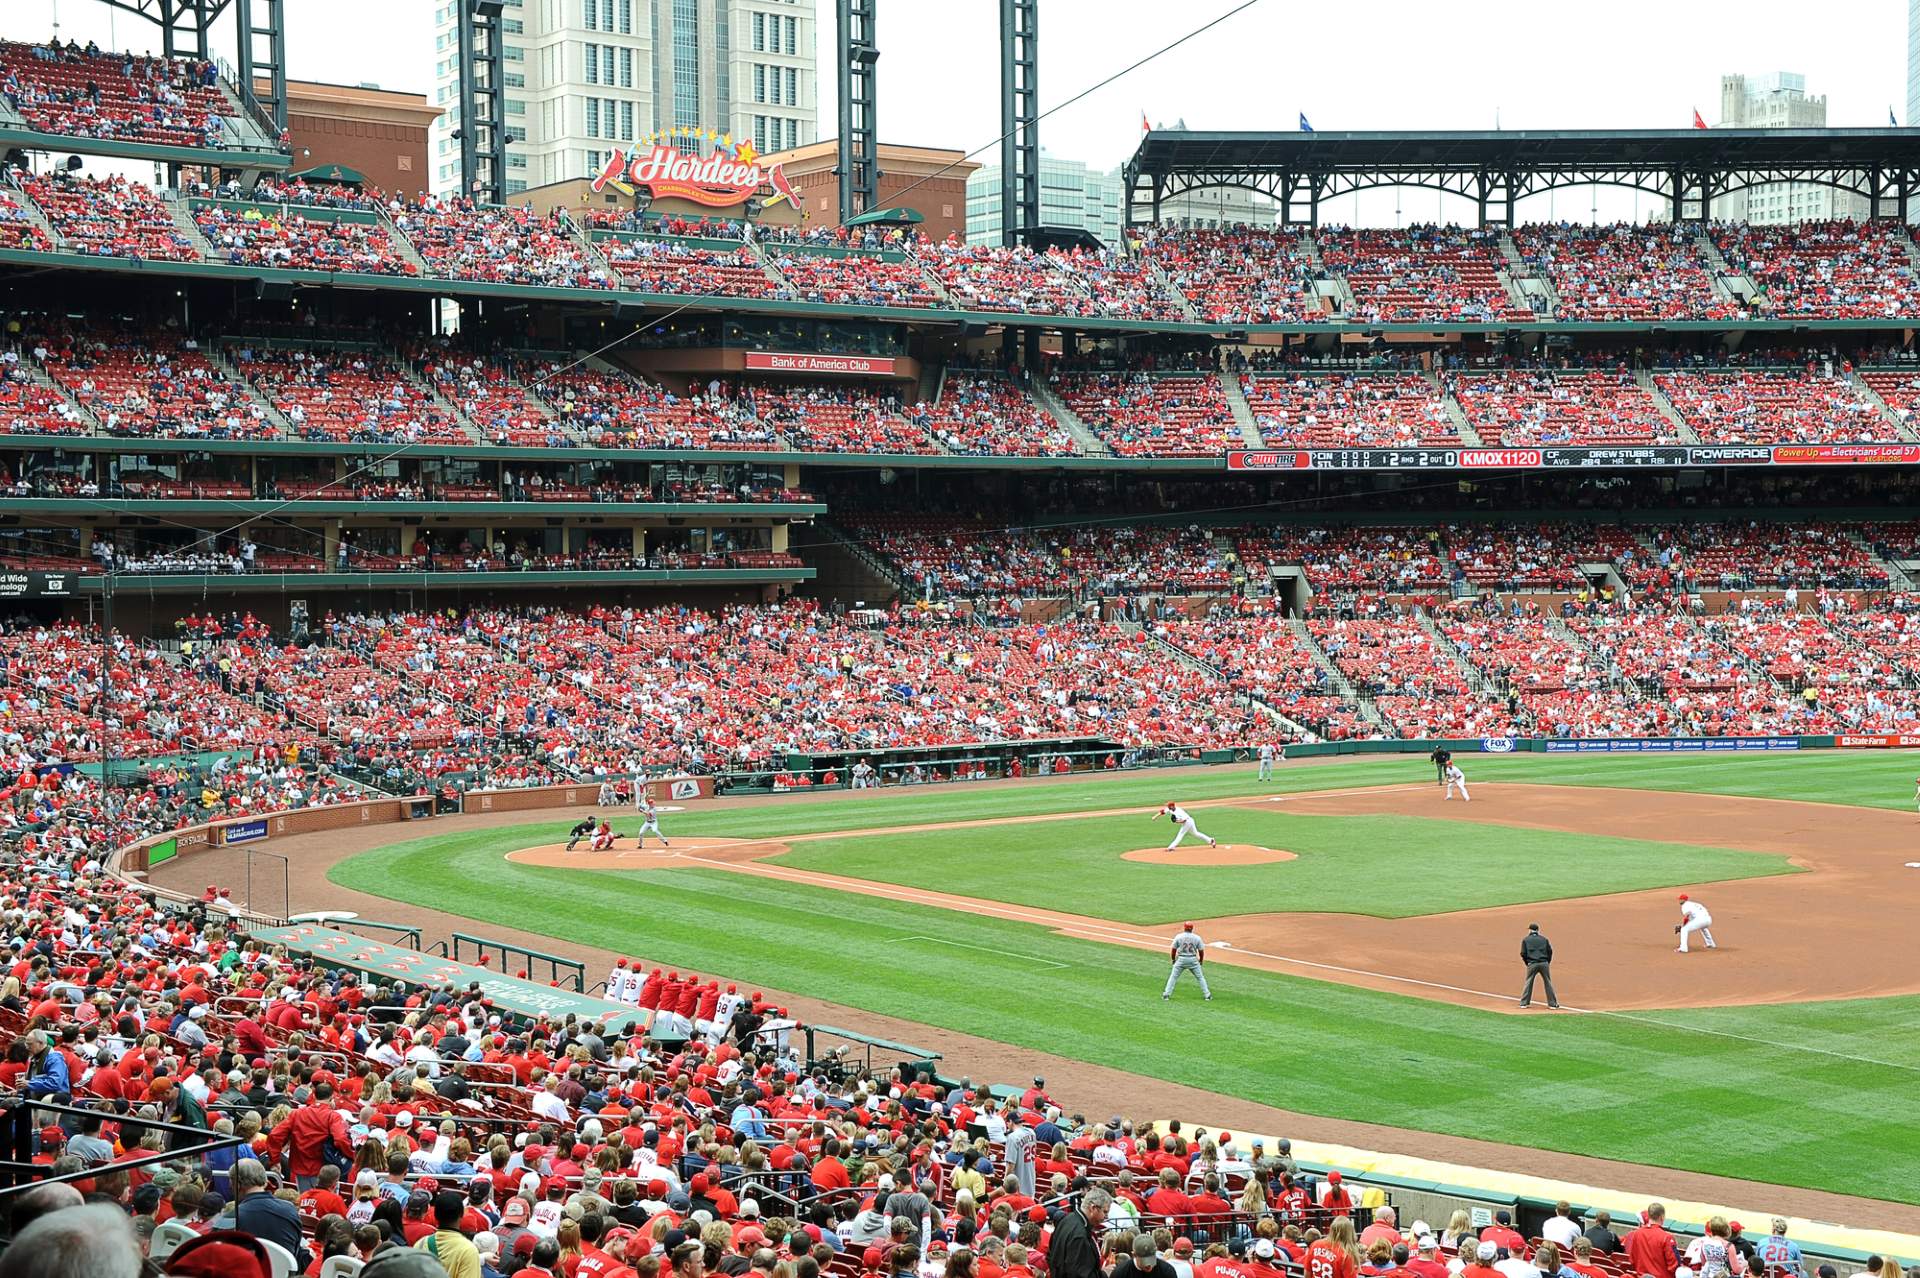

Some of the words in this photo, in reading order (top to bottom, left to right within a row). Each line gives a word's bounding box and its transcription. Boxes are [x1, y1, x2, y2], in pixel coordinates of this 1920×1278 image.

[771, 357, 796, 368] Bank
[798, 358, 807, 368] of
[810, 359, 848, 370] America
[850, 360, 870, 371] Club
[1317, 452, 1333, 460] CIN
[1341, 451, 1348, 460] 0
[1352, 451, 1359, 460] 0
[1363, 451, 1370, 460] 0
[1547, 451, 1559, 459] CF
[1589, 450, 1617, 458] DREW
[1619, 450, 1655, 458] STUBBS
[1692, 449, 1769, 459] POWERADE
[1778, 448, 1804, 456] Power
[1807, 448, 1819, 457] Up
[1882, 447, 1903, 456] Local
[1390, 453, 1399, 466] 2
[1419, 453, 1428, 466] 2
[1445, 452, 1455, 466] 0
[1318, 460, 1334, 468] STL
[1341, 460, 1348, 468] 0
[1352, 460, 1359, 468] 0
[1363, 460, 1370, 468] 0
[7, 574, 28, 582] Wide
[1490, 739, 1507, 747] FOX
[1851, 737, 1868, 745] State
[1868, 737, 1887, 745] Farm
[625, 979, 637, 990] 26
[1765, 1245, 1788, 1262] 20
